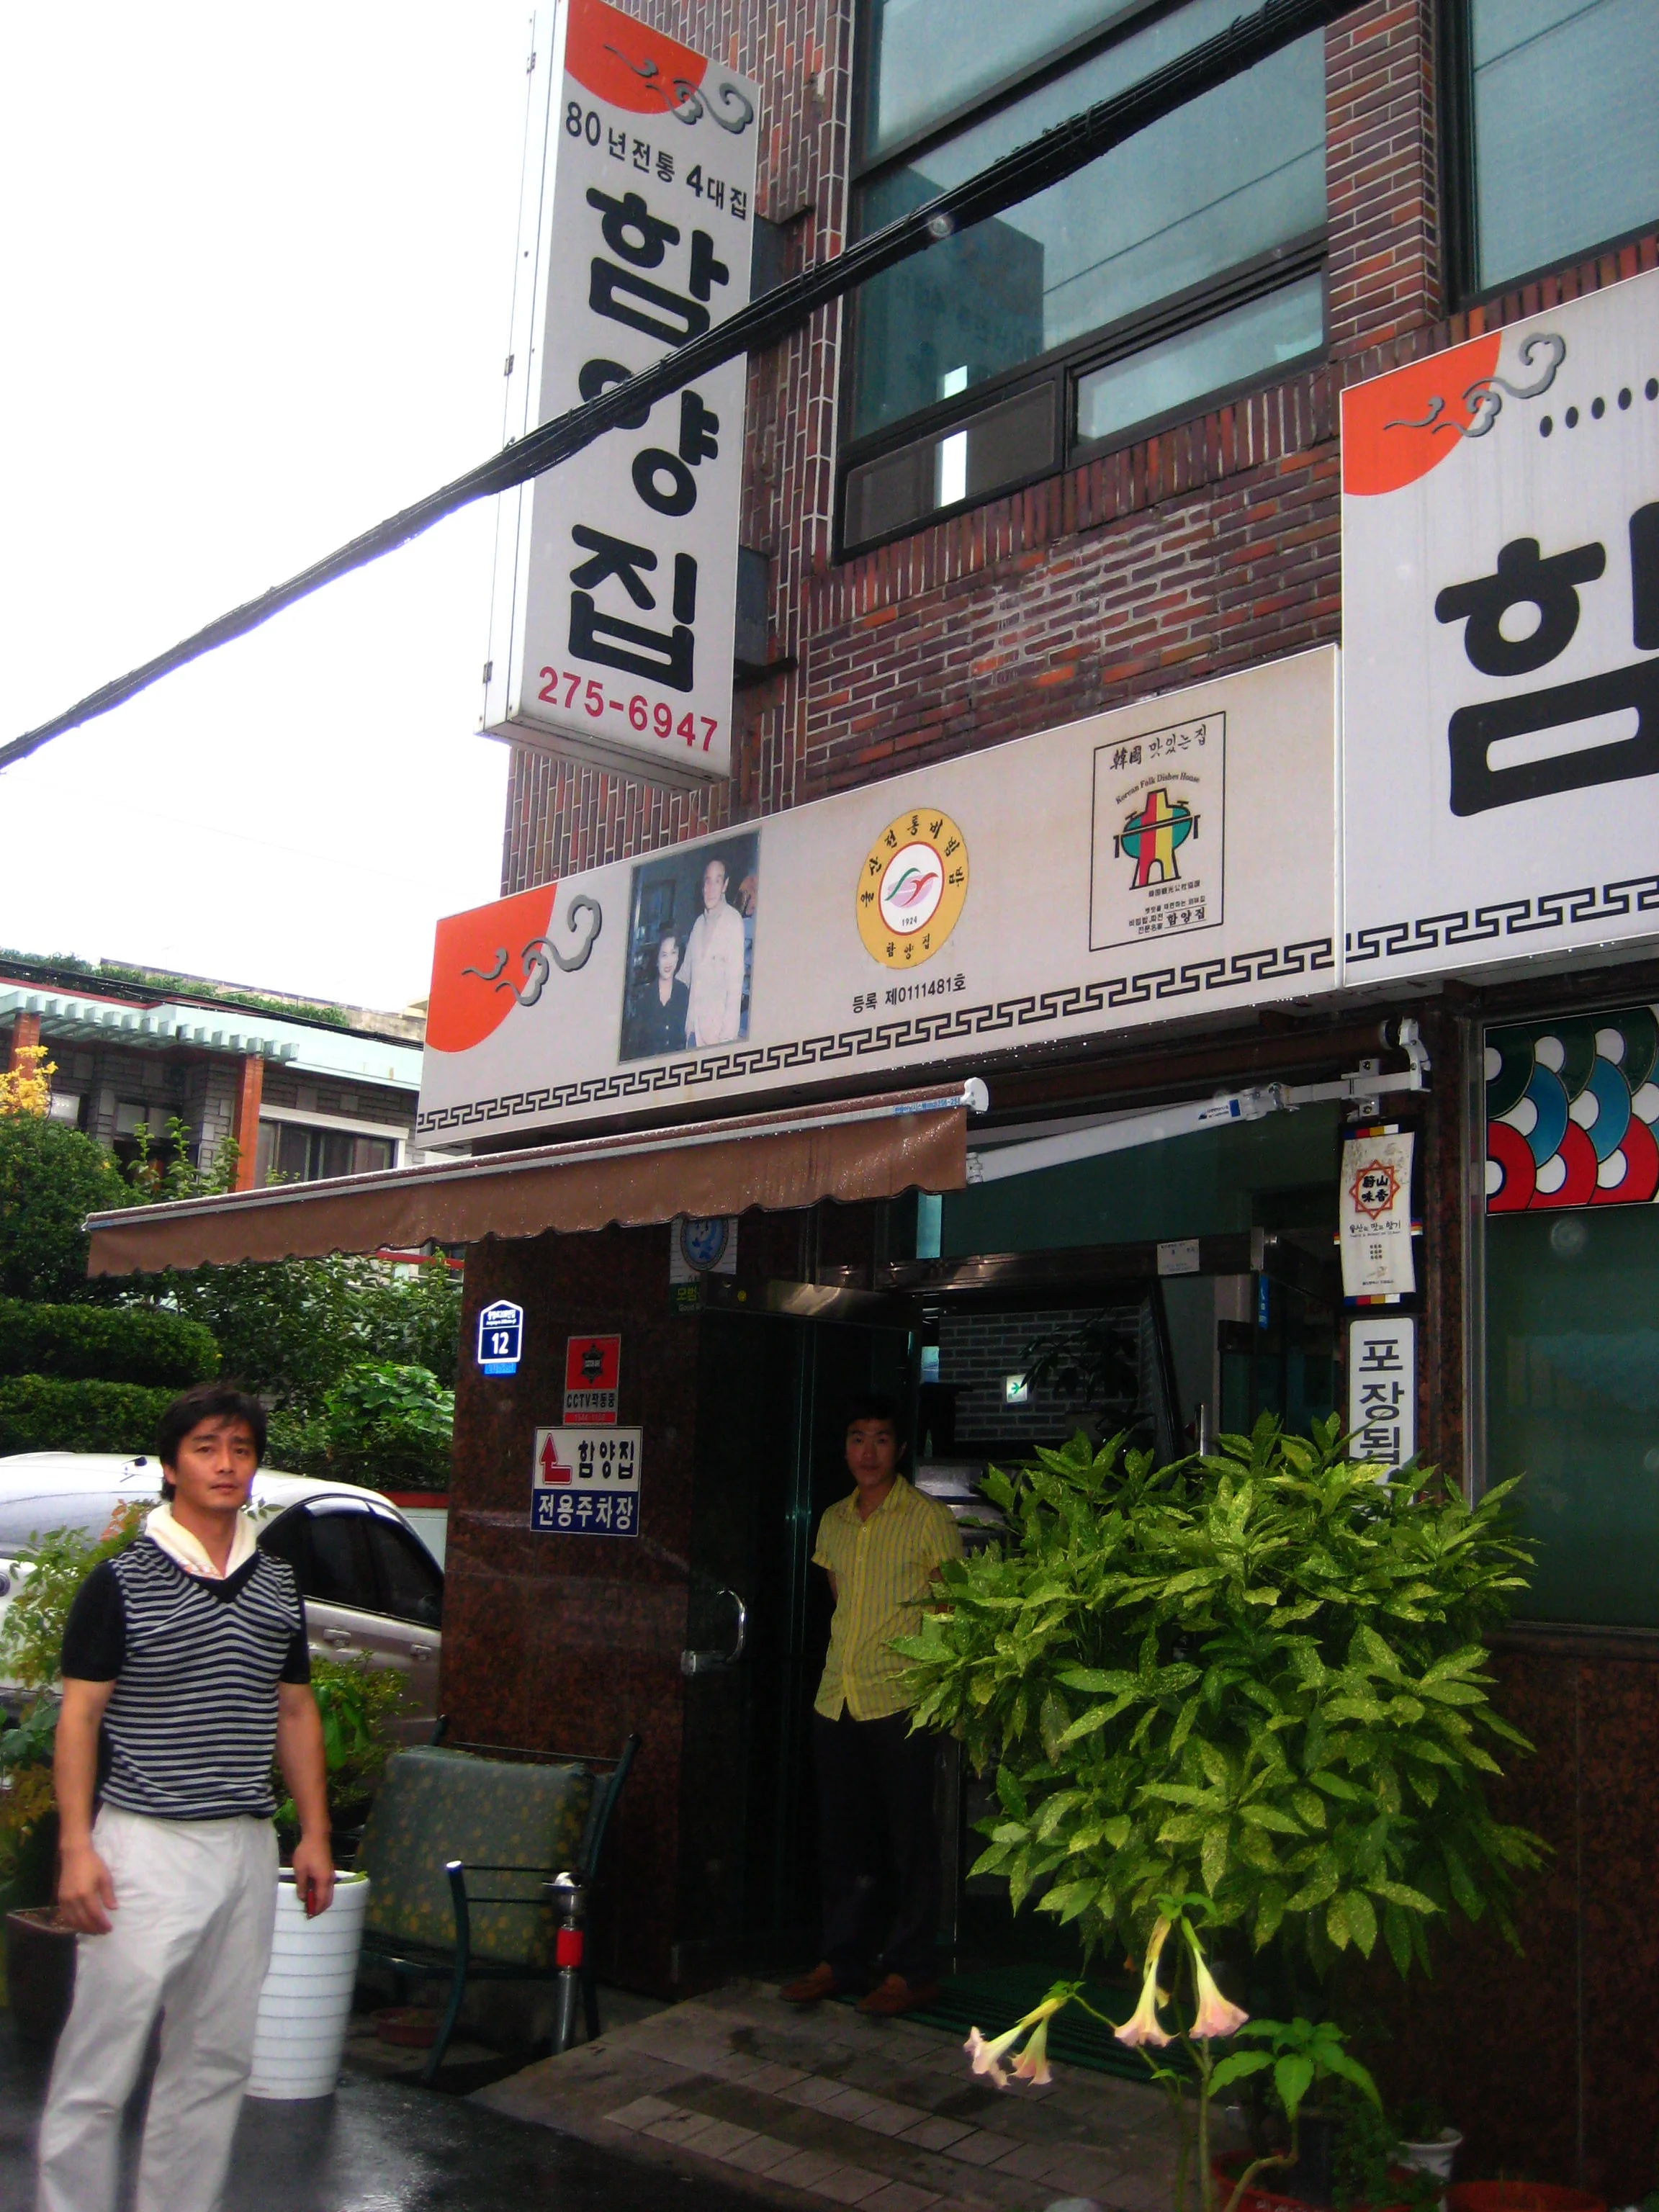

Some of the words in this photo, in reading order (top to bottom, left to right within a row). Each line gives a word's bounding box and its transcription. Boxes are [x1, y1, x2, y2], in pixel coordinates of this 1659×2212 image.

[565, 101, 675, 183] 80년전통
[685, 164, 747, 220] 4대집
[568, 186, 729, 693] 함양집
[538, 665, 718, 752] 275-6947
[1148, 733, 1192, 758] 맛있는
[1194, 723, 1207, 747] 집
[902, 916, 918, 927] 1924
[1166, 907, 1205, 926] 함양집
[852, 992, 878, 1014] 등록
[884, 973, 966, 1005] 제0111481호
[491, 1331, 509, 1354] 12
[566, 1393, 615, 1408] CCTV작동중
[577, 1439, 634, 1480] 함양집
[539, 1493, 634, 1530] 전용주차장
